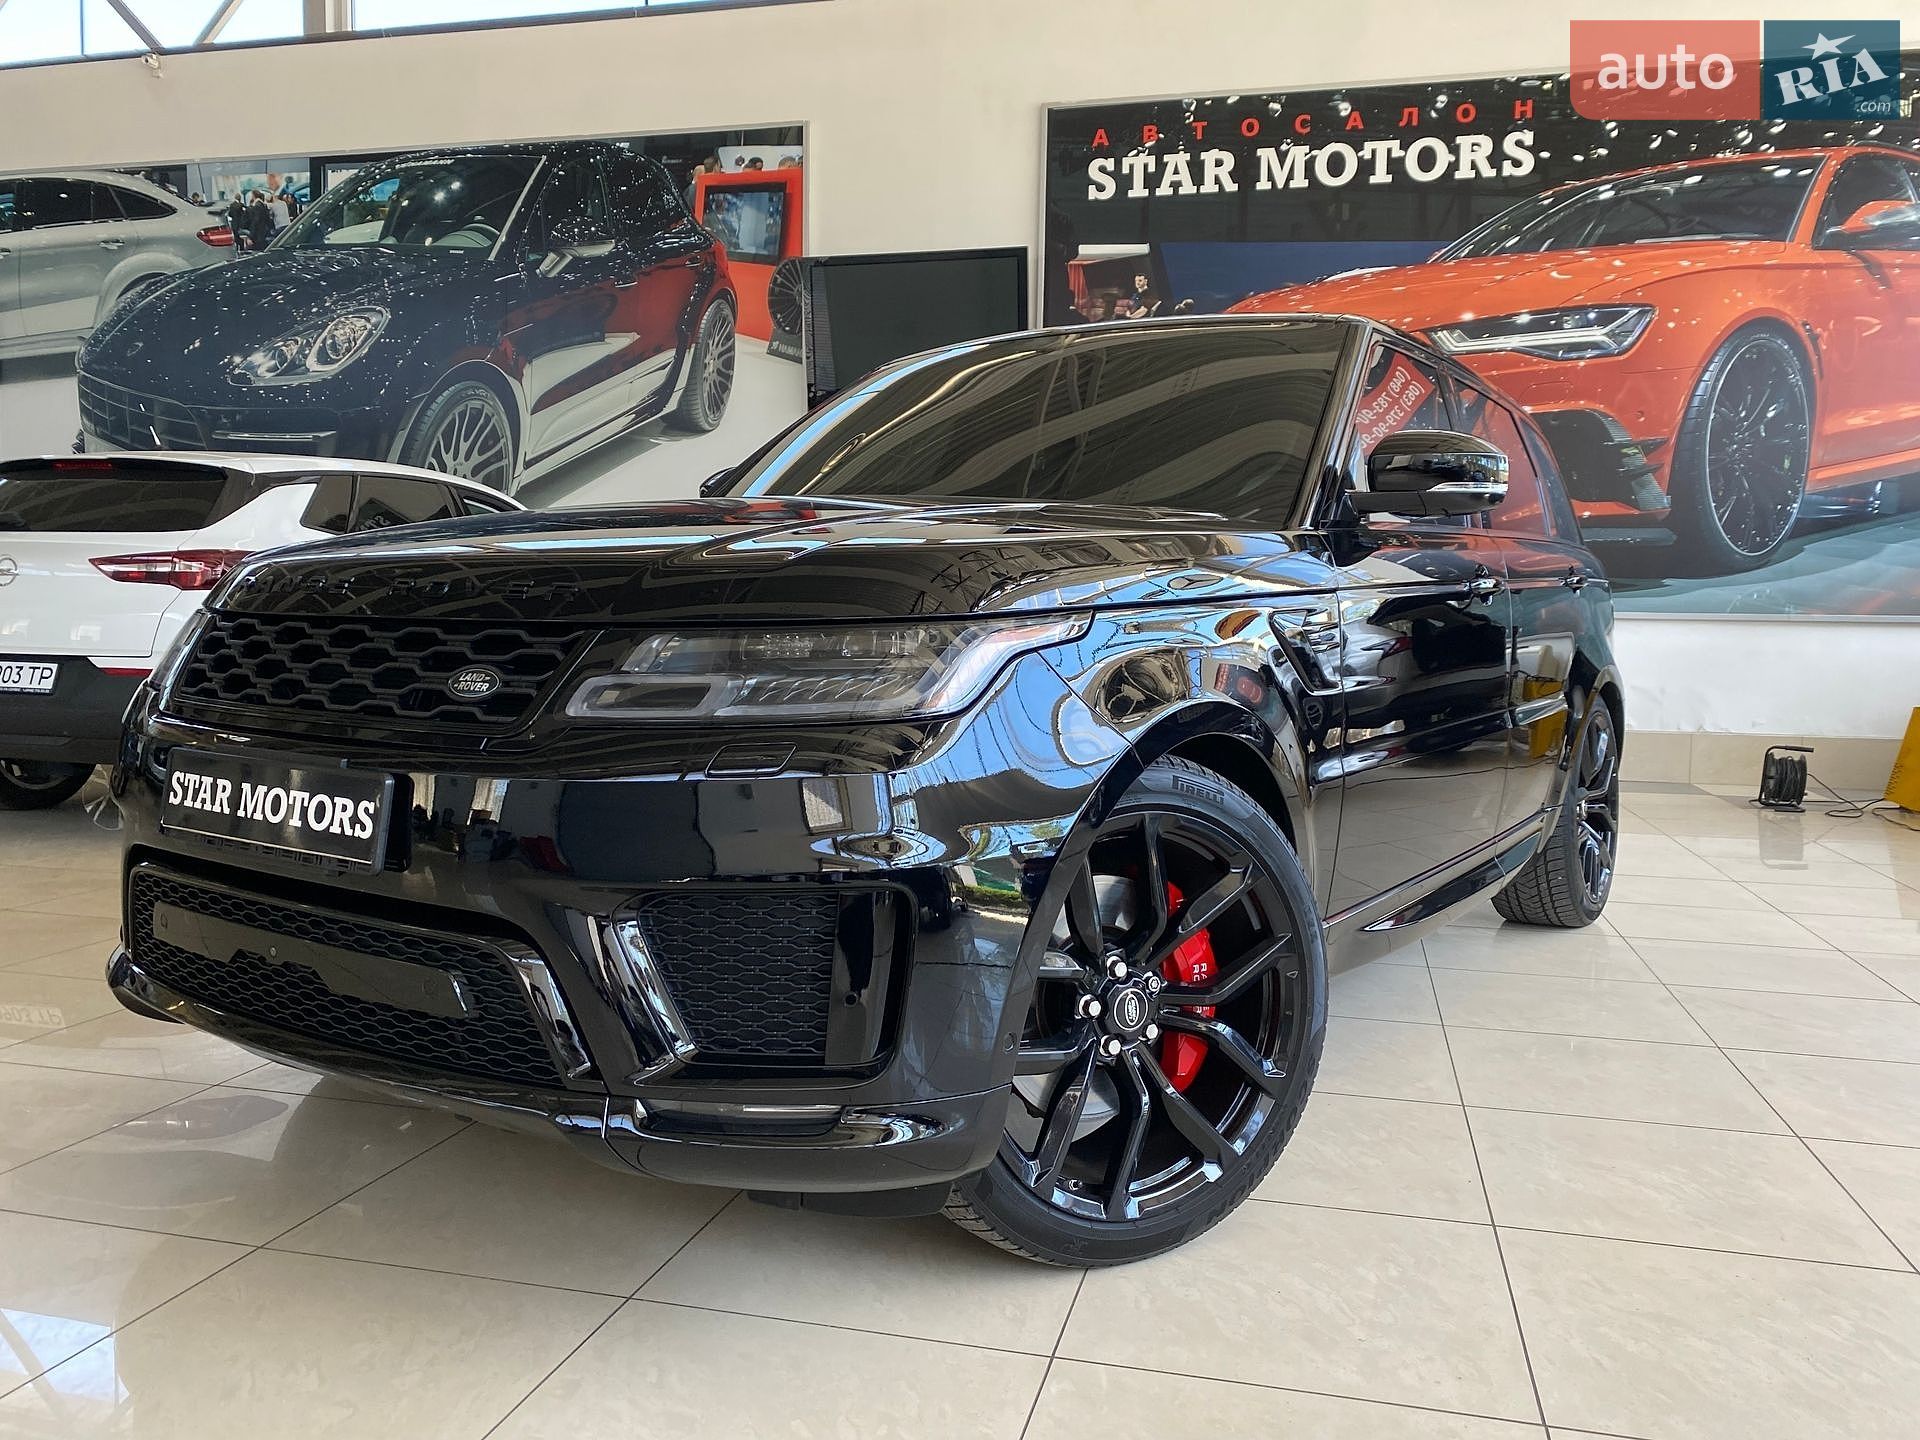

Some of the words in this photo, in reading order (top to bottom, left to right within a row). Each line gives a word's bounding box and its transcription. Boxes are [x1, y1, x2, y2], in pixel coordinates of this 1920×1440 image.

[1092, 98, 1535, 147] АВТОСАЛОН
[1087, 148, 1240, 201] STAR
[1256, 130, 1536, 191] MOTORS
[28, 666, 53, 686] TP
[168, 770, 232, 815] STAR
[236, 782, 375, 840] MOTORS
[1172, 774, 1225, 808] PIRELLI
